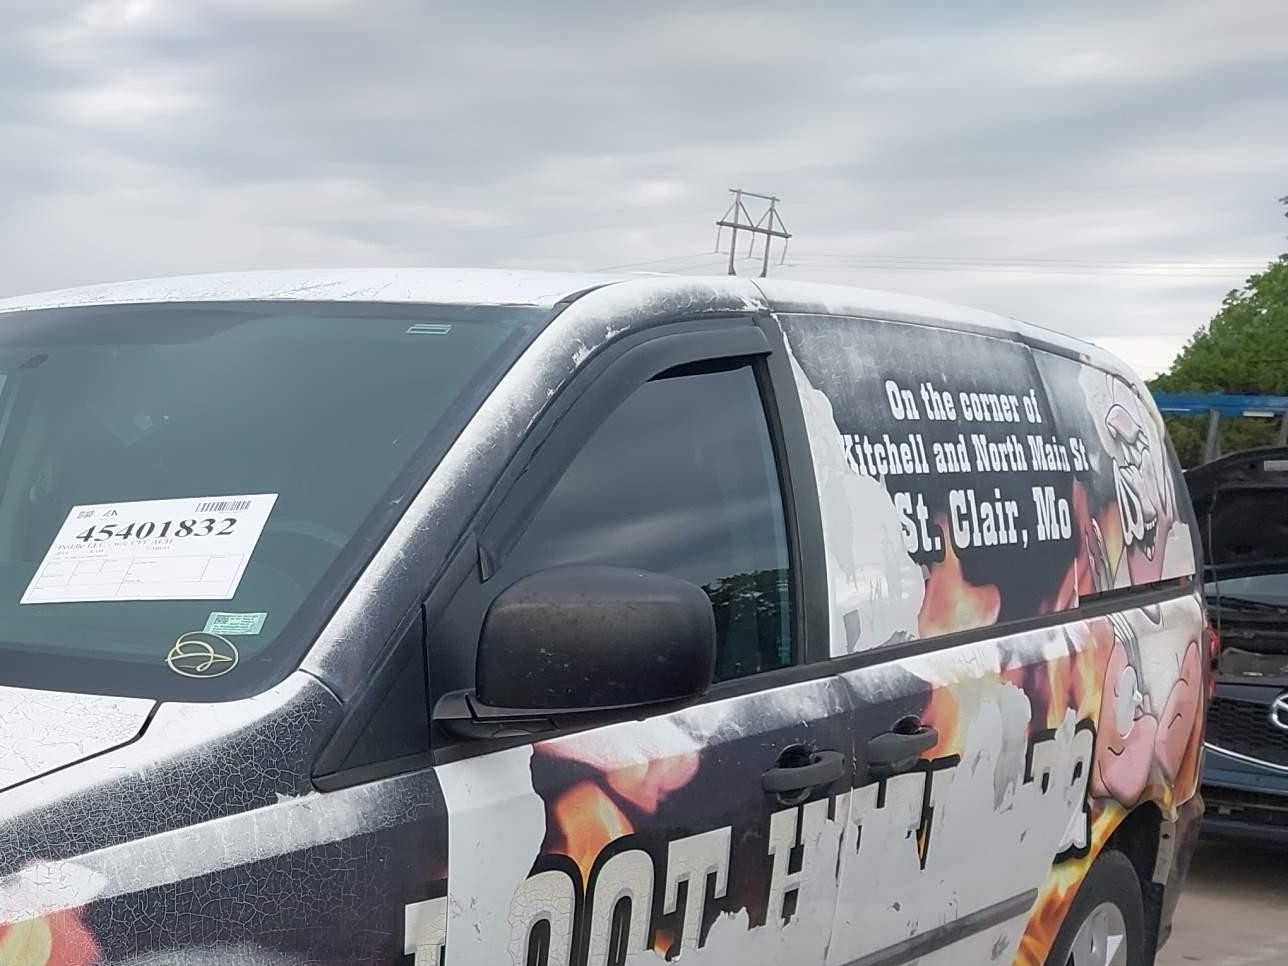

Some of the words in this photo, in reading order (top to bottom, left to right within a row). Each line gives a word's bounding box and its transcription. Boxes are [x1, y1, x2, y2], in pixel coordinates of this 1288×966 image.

[885, 379, 920, 420] On
[920, 382, 956, 421] the
[959, 391, 1020, 423] corner
[1023, 388, 1042, 424] of
[841, 433, 930, 476] Kitchell
[934, 434, 972, 474] and
[970, 434, 1028, 473] North
[1028, 435, 1071, 473] Main
[1069, 437, 1089, 472] St
[75, 517, 238, 543] 45401832
[894, 491, 942, 554] St.
[949, 488, 1028, 549] Clair,
[1031, 486, 1072, 542] Mo
